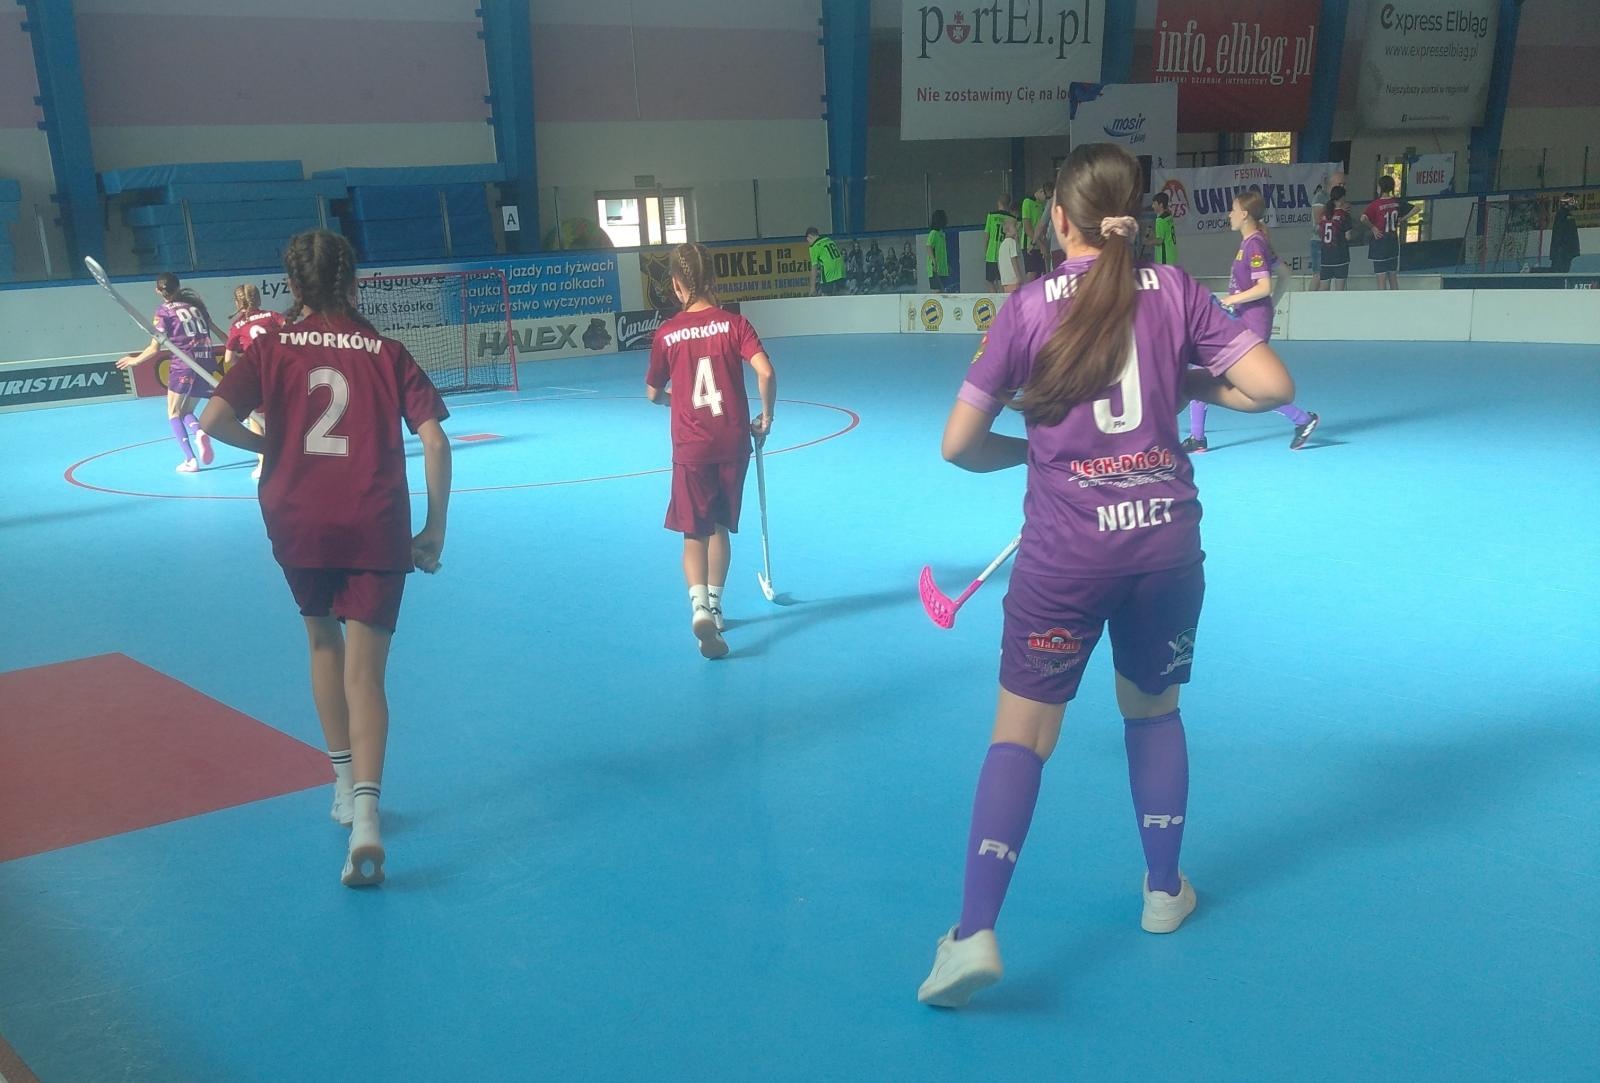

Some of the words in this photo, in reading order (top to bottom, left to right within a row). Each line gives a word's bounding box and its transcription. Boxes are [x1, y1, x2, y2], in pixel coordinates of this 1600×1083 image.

[1446, 10, 1488, 38] Elbląg
[917, 88, 940, 101] Nie
[945, 88, 1012, 104] zostawimy
[1016, 87, 1036, 103] Cię
[1039, 89, 1053, 100] na
[1112, 113, 1146, 131] mosir
[1416, 166, 1445, 185] WEJŚCIE
[507, 213, 516, 224] A
[1324, 222, 1333, 244] 5
[713, 248, 773, 278] OKEJ
[777, 248, 791, 259] na
[825, 244, 841, 260] 16
[508, 264, 542, 281] jazdy
[546, 264, 562, 274] na
[565, 259, 614, 275] łyżwach
[541, 281, 557, 292] na
[560, 276, 605, 291] rolkach
[367, 304, 388, 315] UKS
[543, 293, 613, 311] wyczynowe
[279, 331, 382, 354] TWORKÓW
[664, 321, 729, 347] TWORKÓW
[692, 356, 723, 417] 4
[304, 366, 349, 456] 2
[1097, 498, 1174, 531] NOLET
